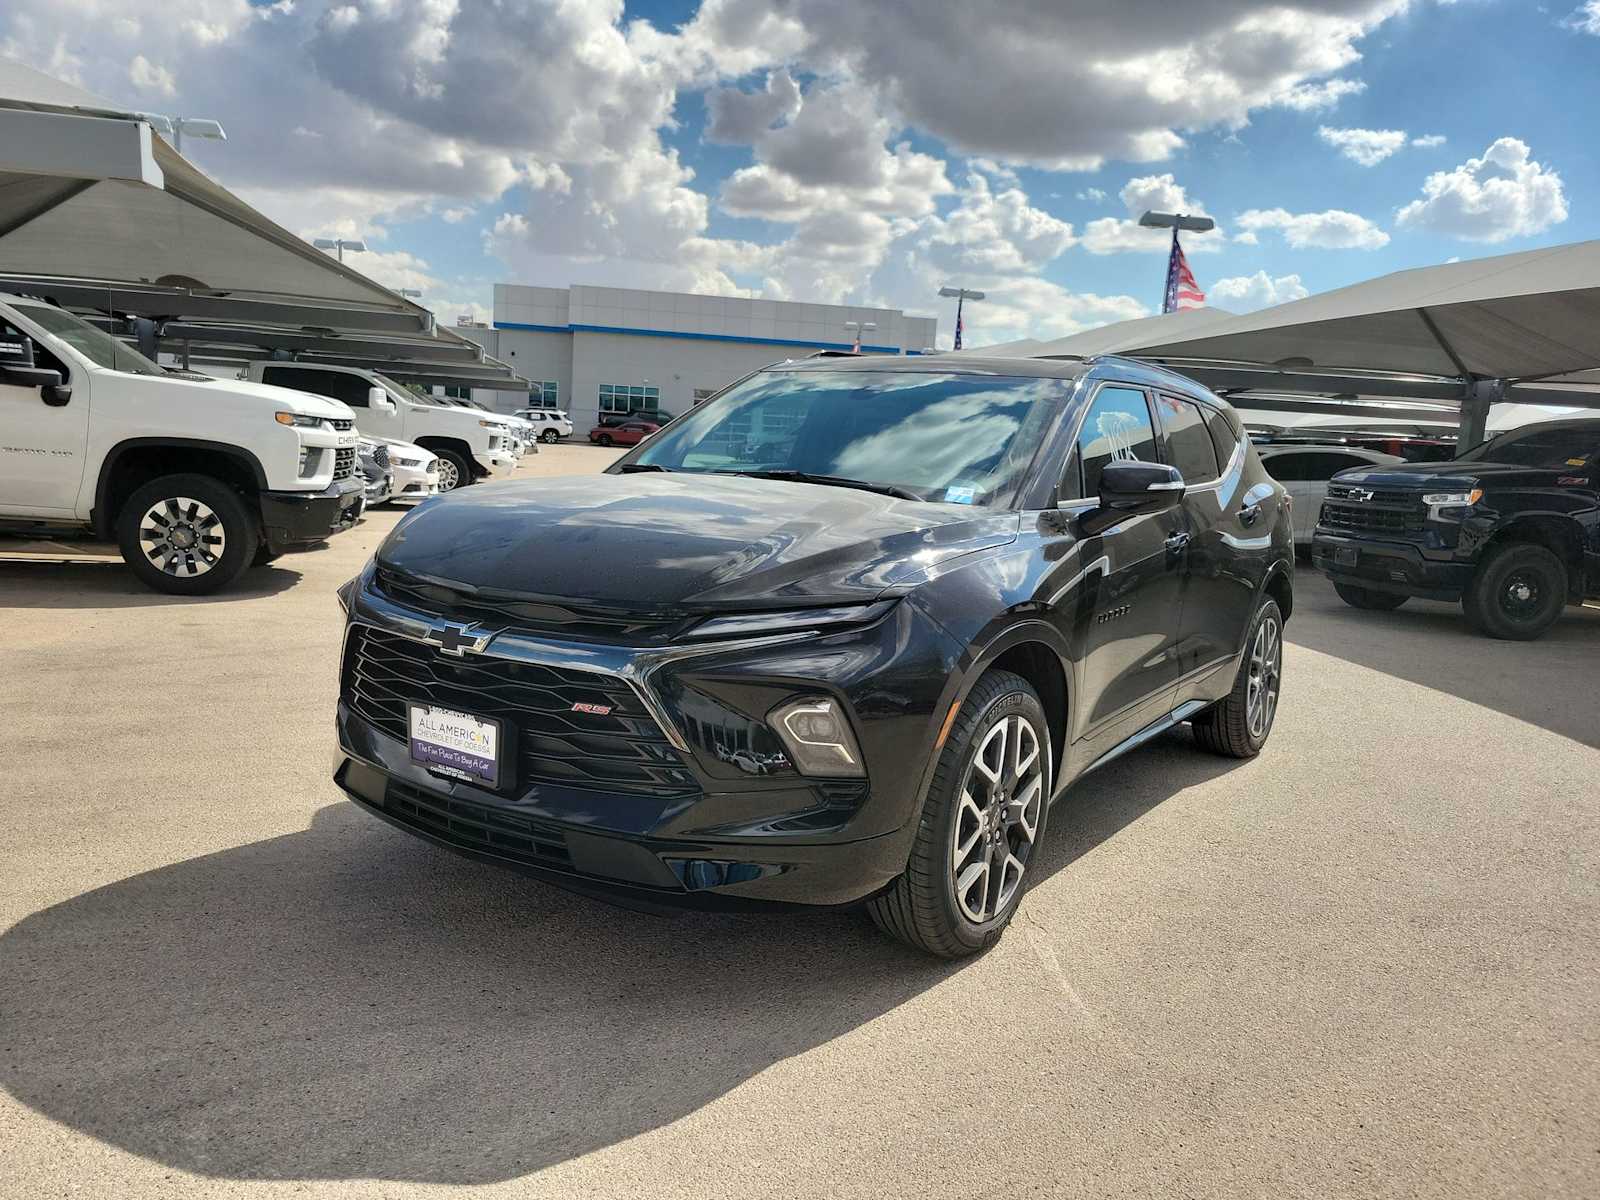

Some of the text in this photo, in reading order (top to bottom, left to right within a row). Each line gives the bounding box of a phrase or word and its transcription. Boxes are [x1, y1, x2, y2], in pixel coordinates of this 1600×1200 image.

[571, 702, 611, 715] RS
[418, 717, 439, 731] ALL
[417, 728, 491, 754] CHEVROLET OF ODESSA
[417, 742, 428, 753] The
[438, 748, 454, 760] Place
[453, 752, 461, 762] To
[461, 755, 472, 769] Buy
[472, 758, 479, 768] A
[479, 760, 489, 770] Car
